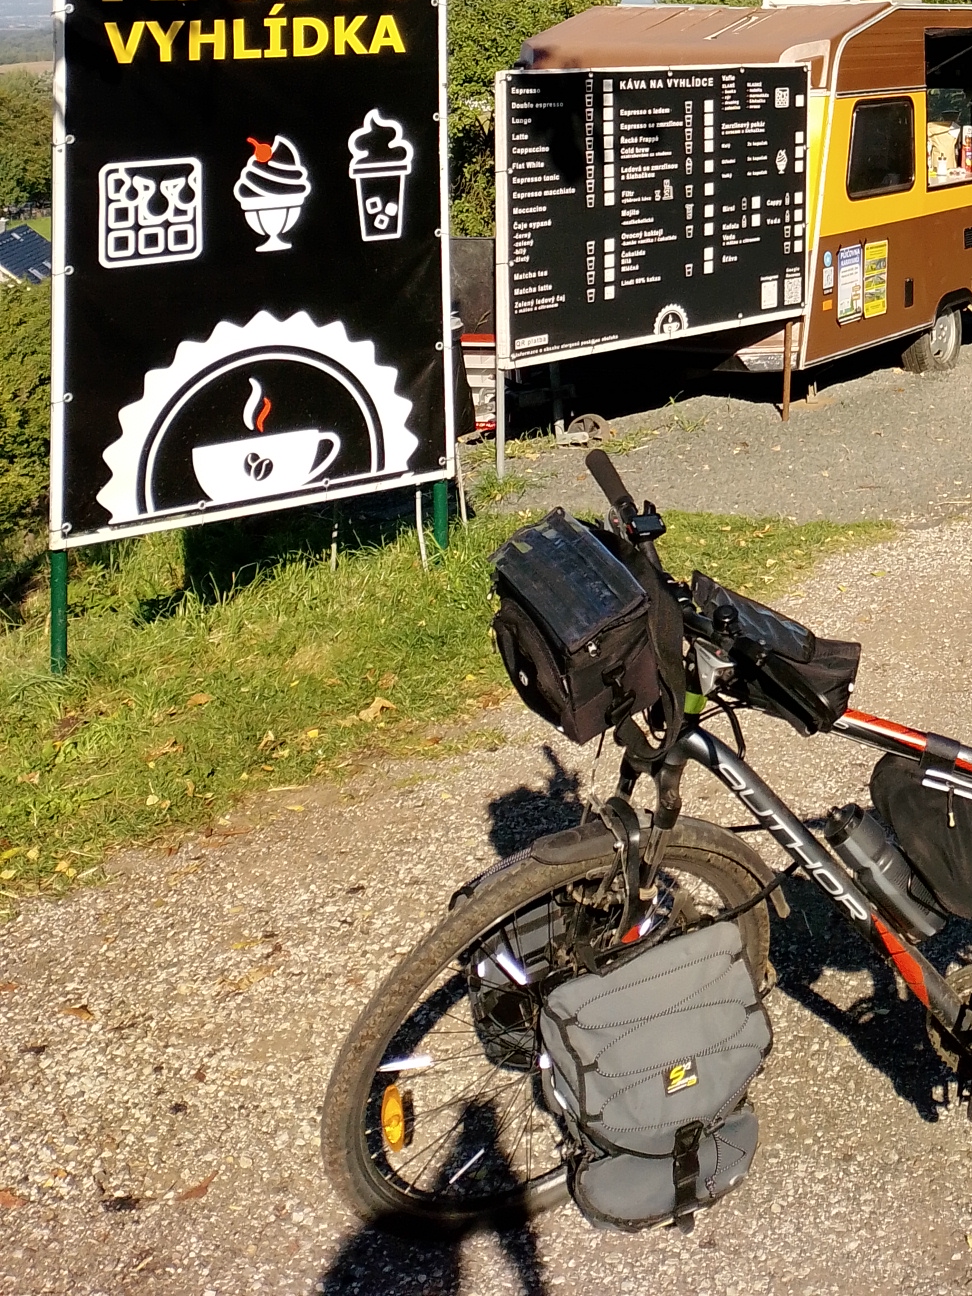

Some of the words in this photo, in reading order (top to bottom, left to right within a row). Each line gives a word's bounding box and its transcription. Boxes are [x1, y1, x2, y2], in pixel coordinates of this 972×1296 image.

[105, 3, 406, 63] VYHLÍDKA
[620, 78, 647, 90] KÁVA
[650, 79, 664, 89] NA
[667, 76, 714, 88] VYHLÍDCE
[511, 87, 541, 95] Espresso
[620, 108, 647, 116] Espresso
[620, 122, 647, 130] Espresso
[512, 146, 550, 154] Cappuccino
[512, 176, 542, 185] Espresso
[512, 190, 542, 199] Espresso
[543, 187, 576, 196] macchiato
[514, 272, 537, 281] Matcha
[514, 287, 537, 295] Matcha
[538, 284, 553, 292] latte
[514, 299, 534, 308] Zelený
[719, 763, 868, 920] AUTHOR
